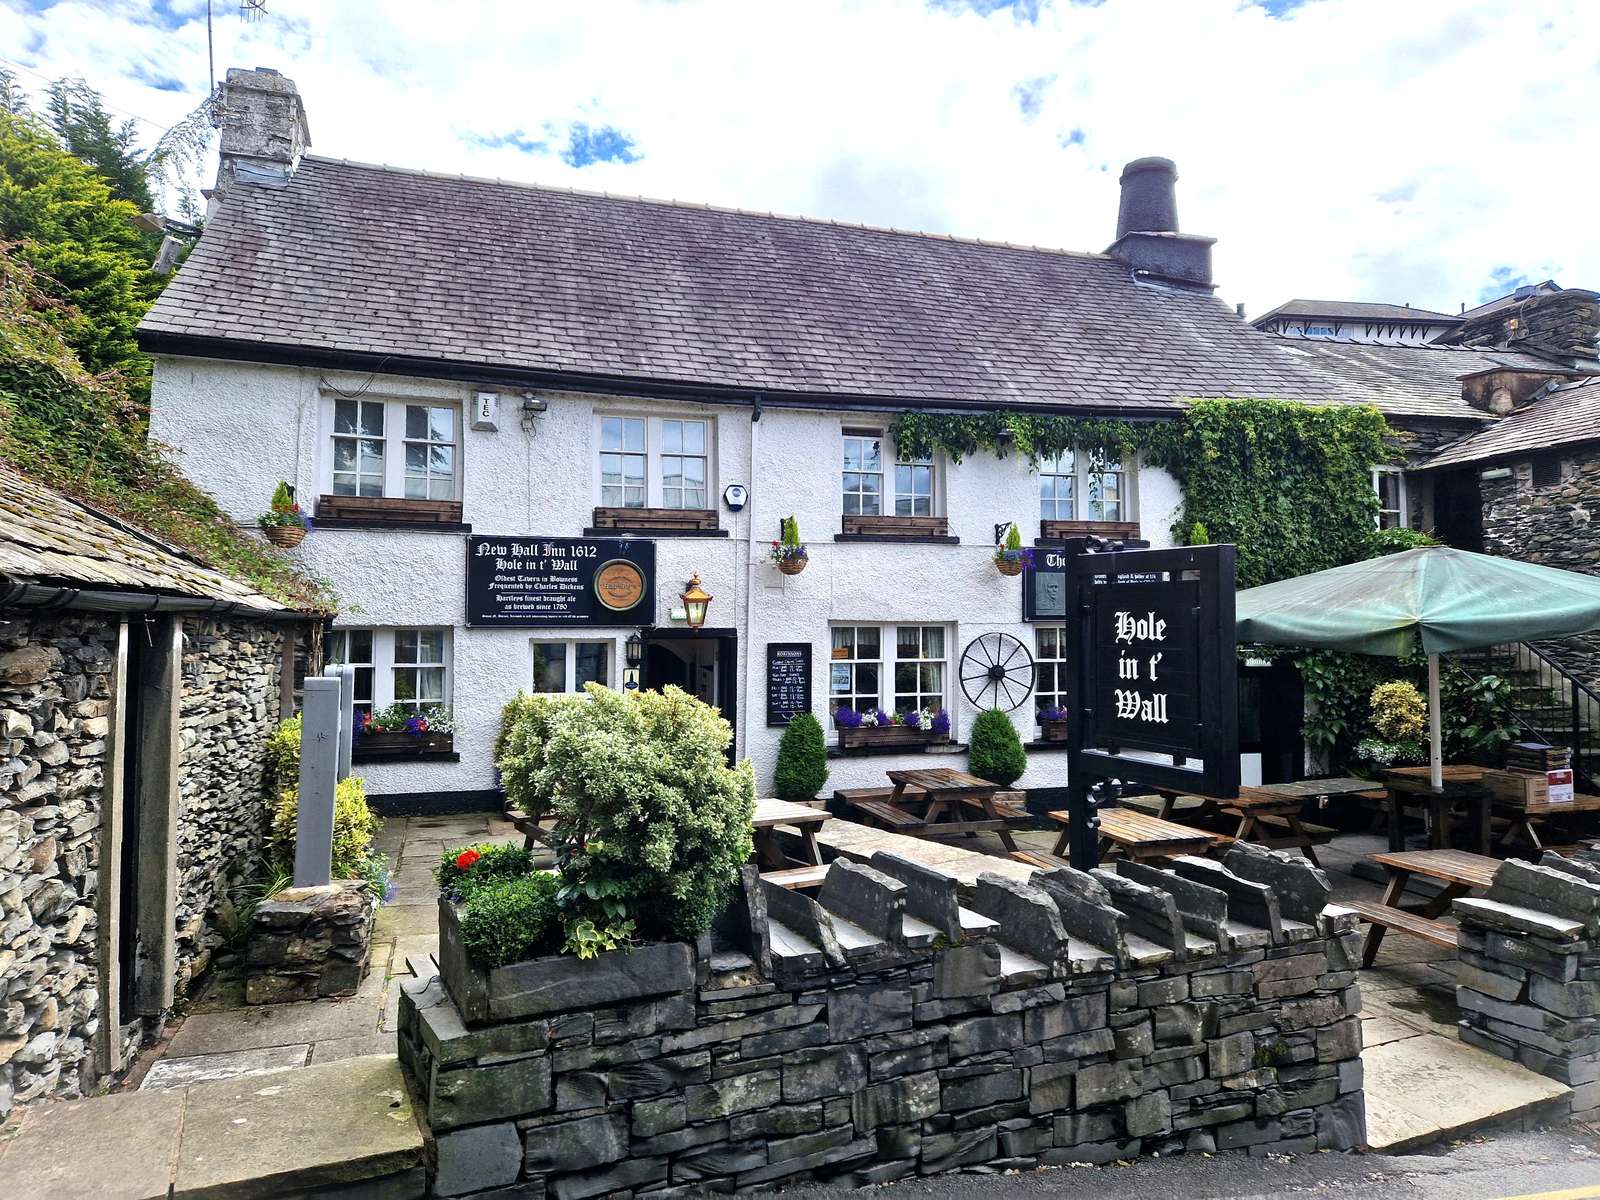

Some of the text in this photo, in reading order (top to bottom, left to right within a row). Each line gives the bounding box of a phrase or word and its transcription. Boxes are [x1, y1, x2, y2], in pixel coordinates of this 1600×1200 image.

[482, 398, 490, 417] TEC
[475, 542, 597, 558] New Hall Inn 1612
[495, 558, 523, 571] Hole
[526, 559, 536, 570] in
[551, 559, 578, 571] Wall
[488, 582, 524, 590] Frequented
[494, 574, 516, 582] Oldest
[549, 575, 578, 583] Bowness
[495, 594, 524, 602] Hartleys
[1114, 611, 1167, 645] Hole
[1118, 650, 1139, 680] in
[1114, 688, 1169, 724] Wall
